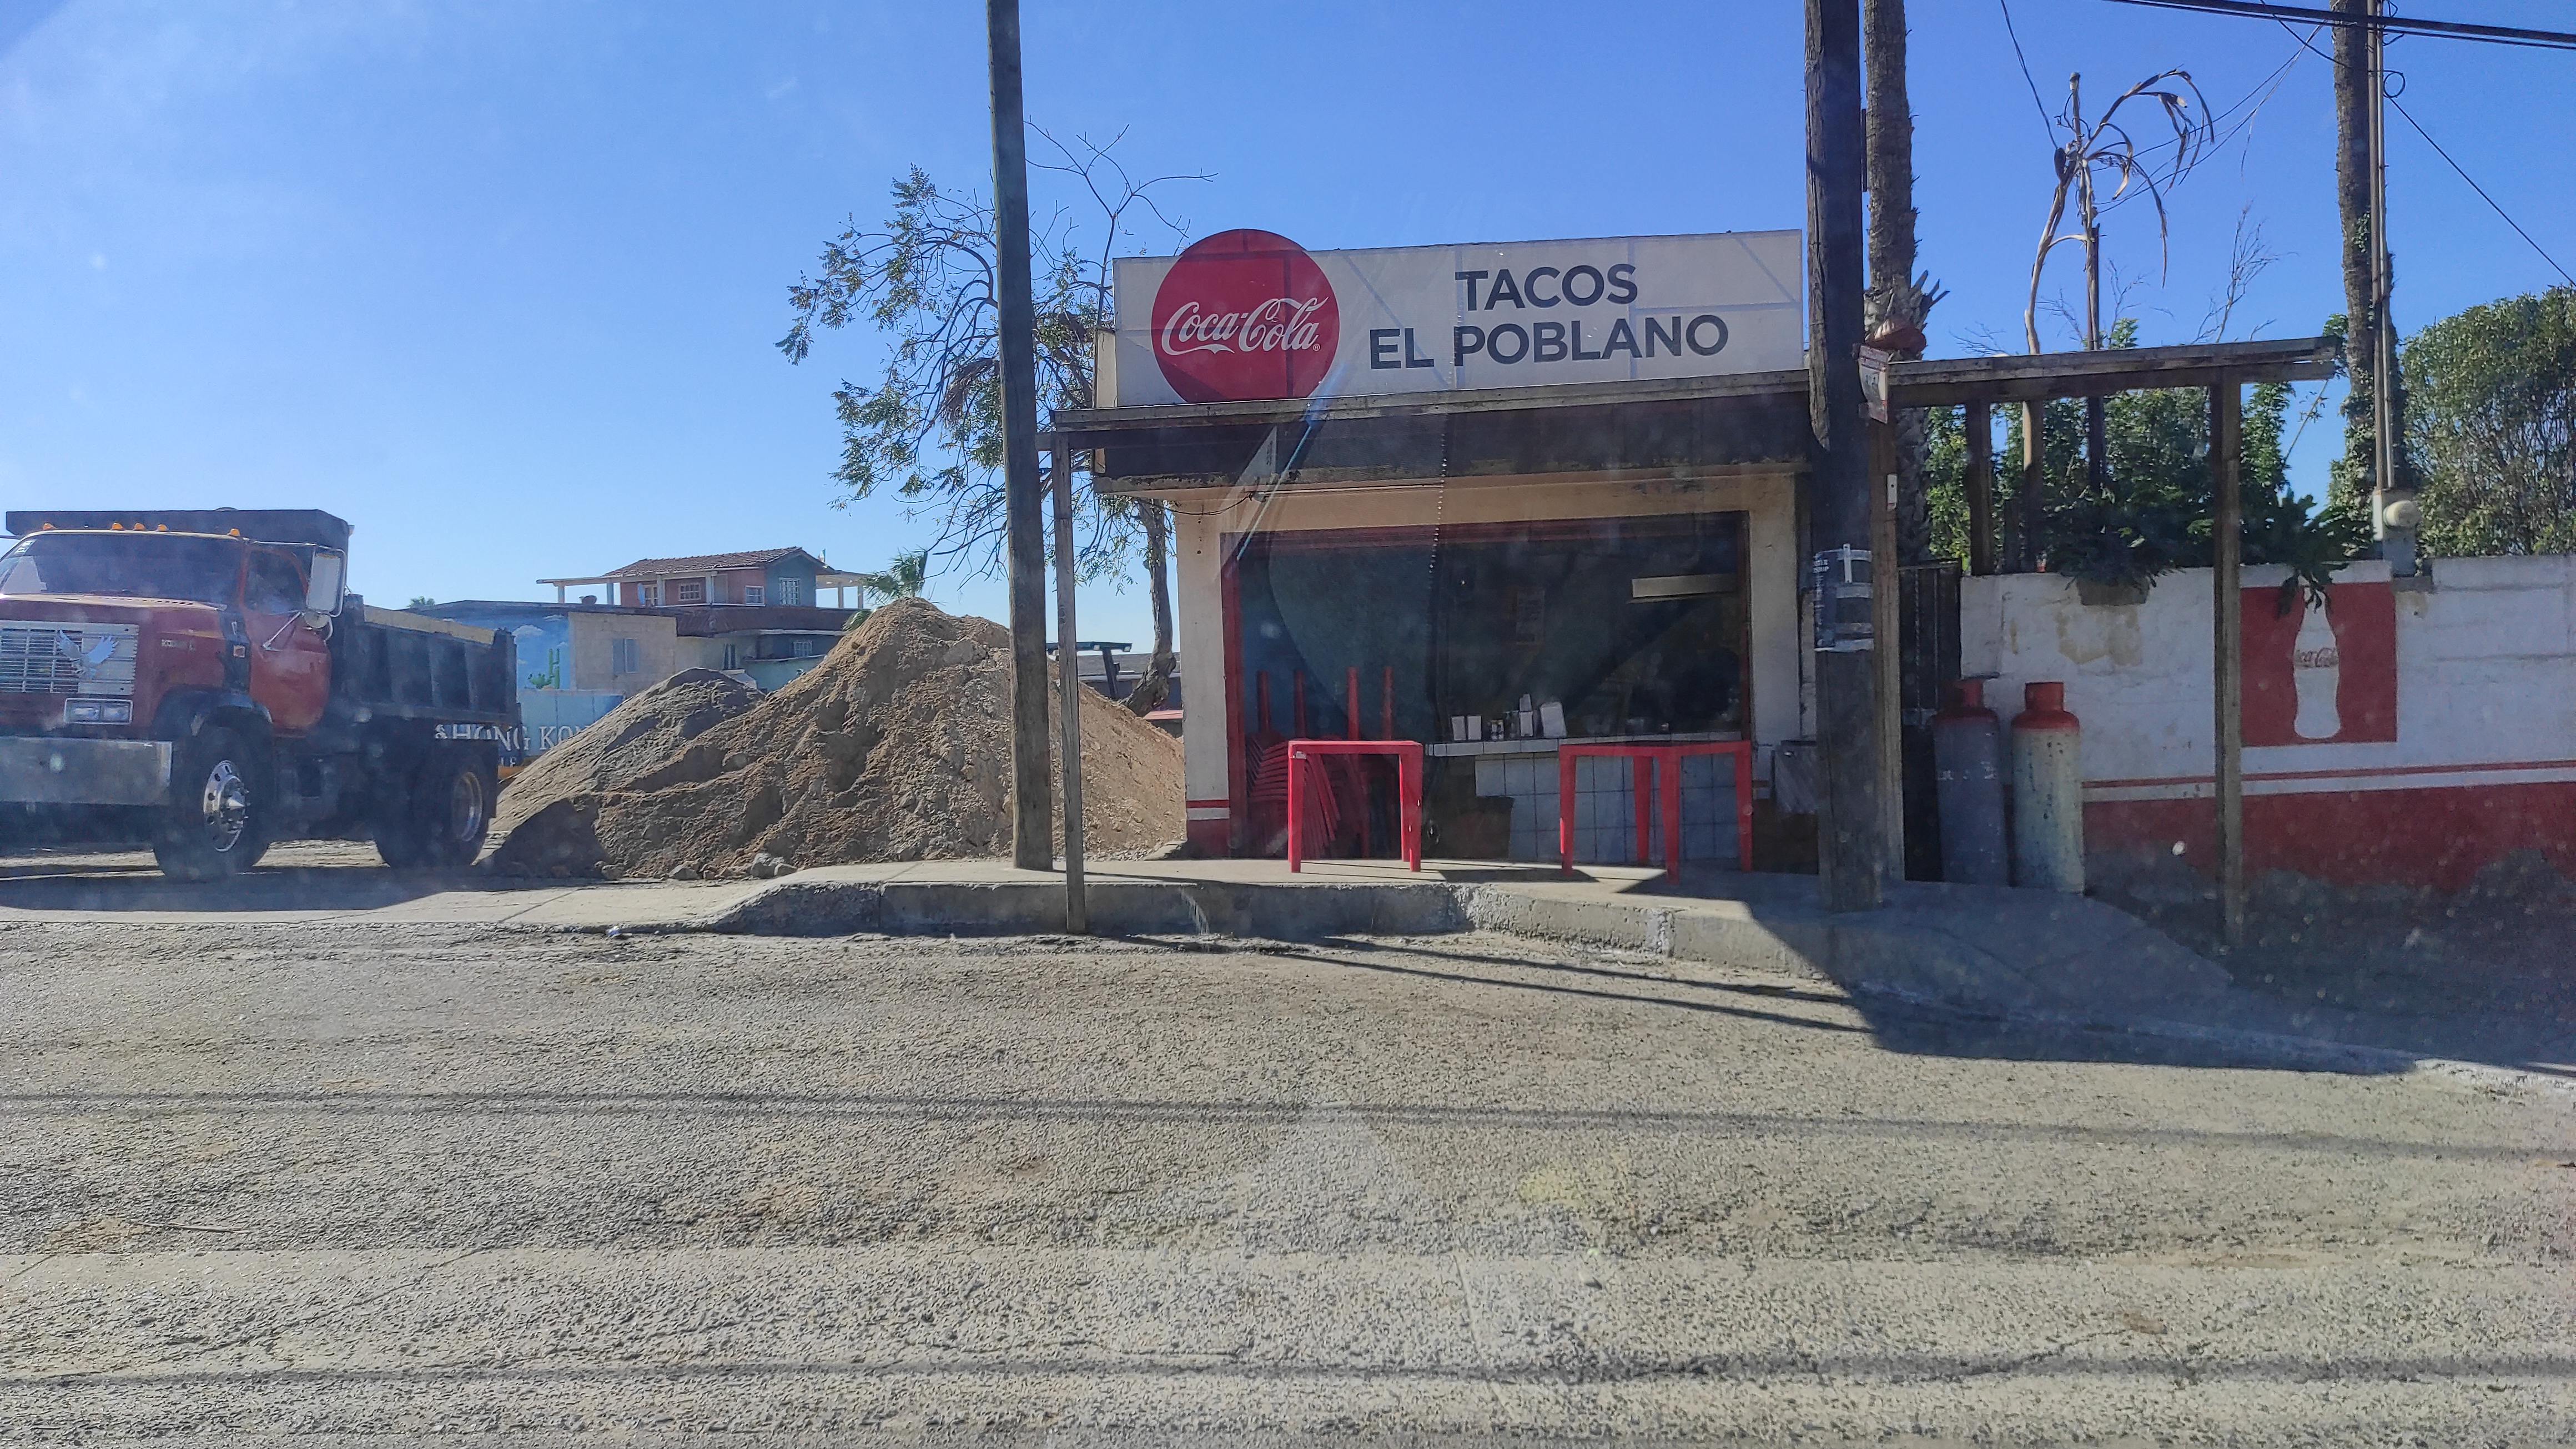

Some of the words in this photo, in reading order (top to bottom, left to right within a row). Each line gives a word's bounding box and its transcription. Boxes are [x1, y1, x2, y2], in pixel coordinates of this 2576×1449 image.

[1455, 263, 1638, 311] TACOS
[1161, 296, 1329, 356] Coca-Cola
[1369, 328, 1435, 370] EL
[1453, 314, 1729, 367] POBLANO
